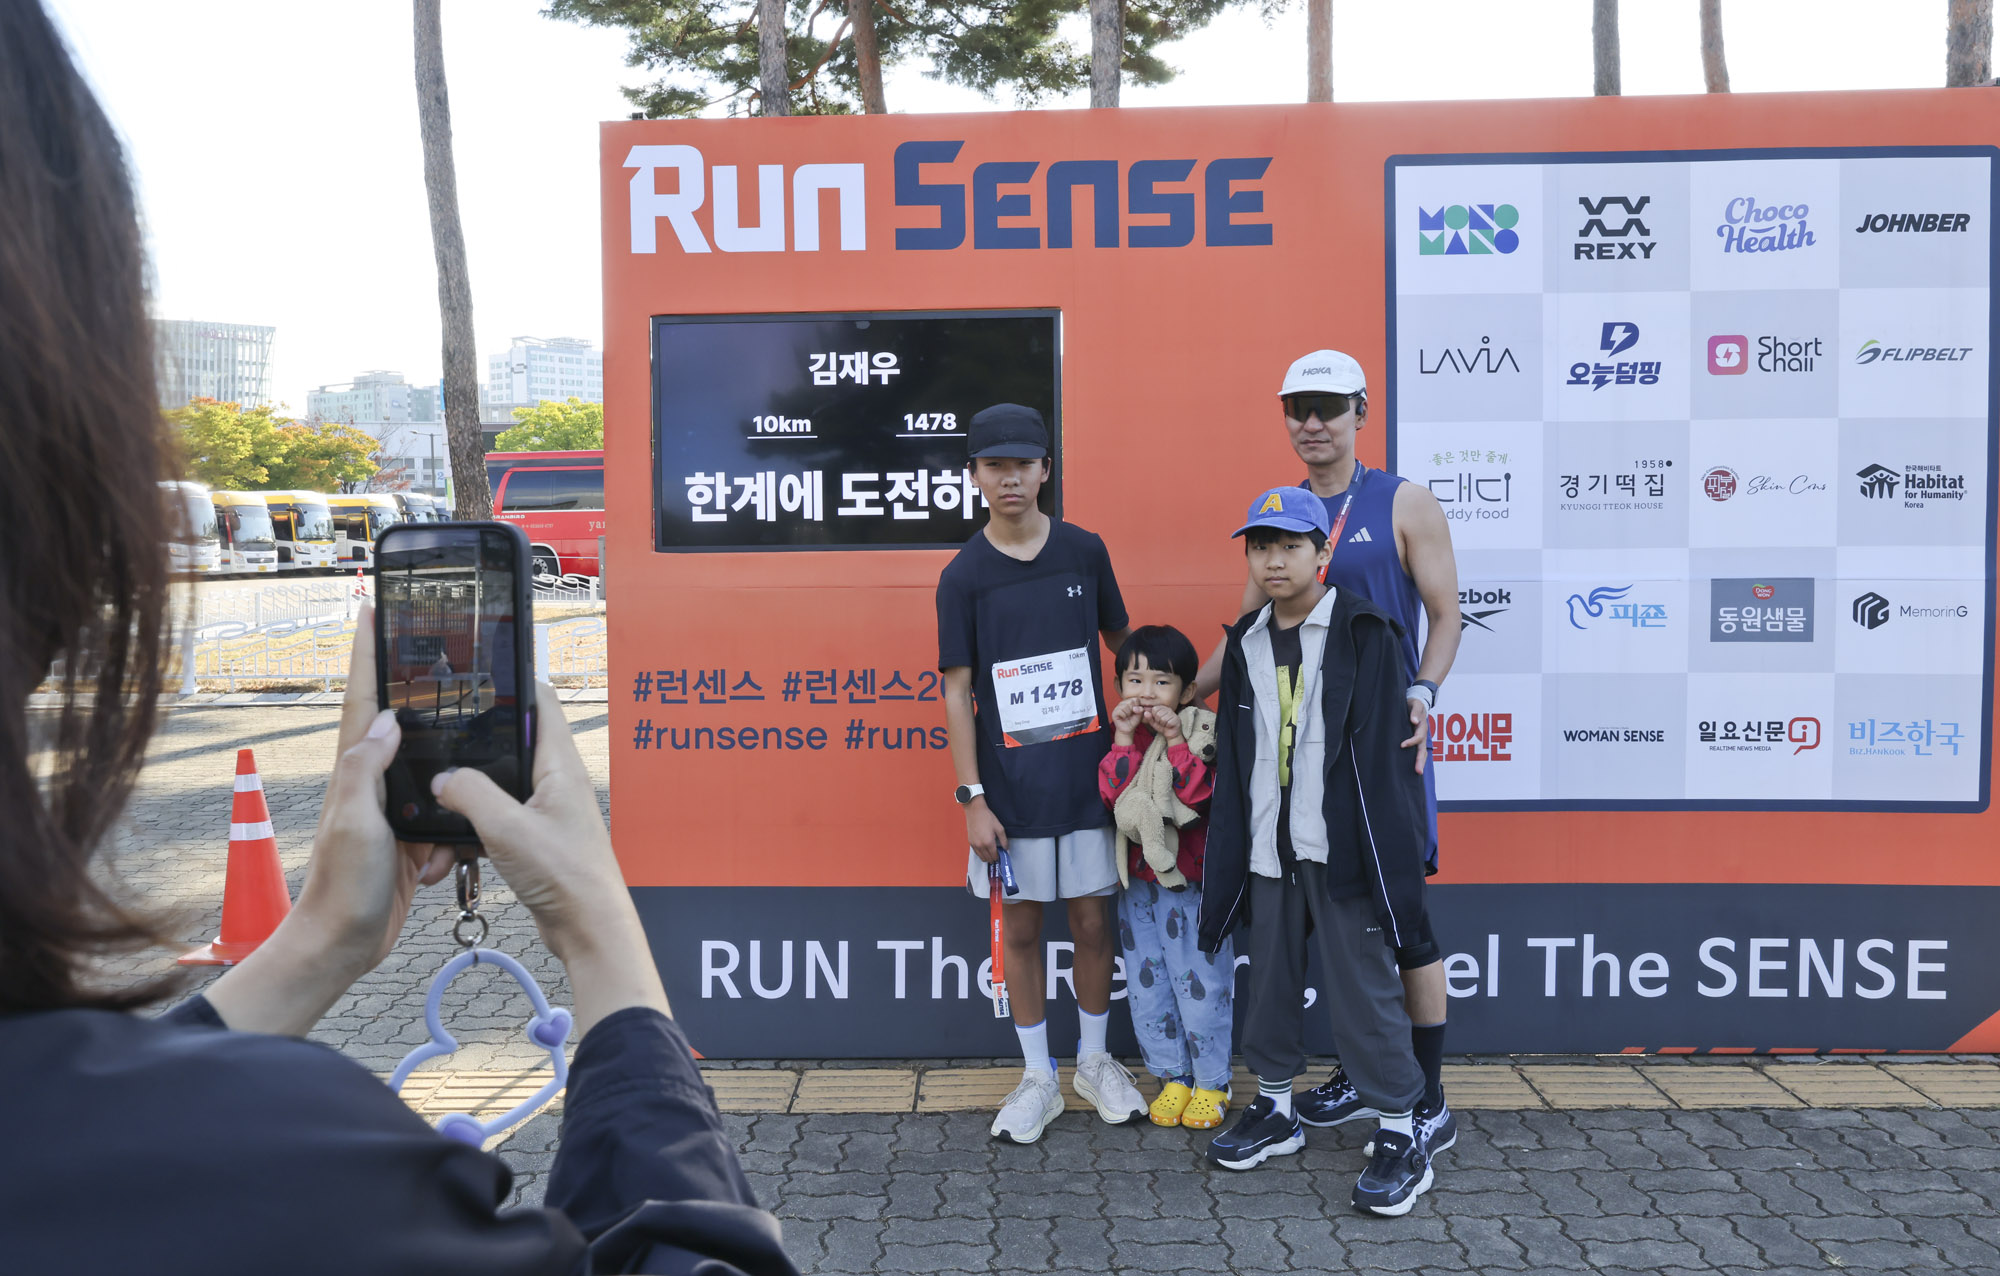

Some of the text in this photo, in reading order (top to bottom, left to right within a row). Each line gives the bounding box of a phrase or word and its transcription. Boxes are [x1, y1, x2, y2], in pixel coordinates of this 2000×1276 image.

[622, 144, 867, 254] Run
[1724, 197, 1809, 224] Choco
[1856, 213, 1970, 233] JOHNBER
[1716, 220, 1816, 253] Health
[1574, 242, 1657, 260] REXY
[1758, 336, 1822, 356] Short
[1881, 348, 1973, 361] FLIPBELT
[808, 351, 901, 386] 김재우
[1302, 367, 1331, 376] HOKA
[753, 414, 811, 434] 10km
[904, 412, 957, 432] 1478
[1432, 451, 1455, 466] 좋은
[1459, 450, 1481, 462] 것만
[1634, 460, 1664, 469] 1958
[1560, 474, 1664, 498] 경기떡집
[1746, 475, 1785, 495] Skin
[1904, 473, 1965, 489] Habitat
[685, 468, 988, 522] 한계에 도전하
[1259, 493, 1284, 514] A
[1904, 490, 1918, 499] for
[1446, 508, 1509, 522] ddy food
[1634, 502, 1664, 510] HOUSE
[1718, 606, 1806, 633] 동원샘물
[1900, 605, 1968, 617] MemorinG
[997, 668, 1019, 679] Run
[633, 669, 946, 704] #런센스 #런센스2
[1010, 678, 1083, 705] M 1478
[633, 719, 828, 750] #runsense
[1563, 730, 1664, 742] WOMAN SENSE
[1698, 721, 1785, 742] 일요신문
[1848, 719, 1965, 755] 비즈한국
[701, 940, 849, 999] RUN
[1527, 934, 1670, 998] The
[1697, 936, 1948, 1000] SENSE
